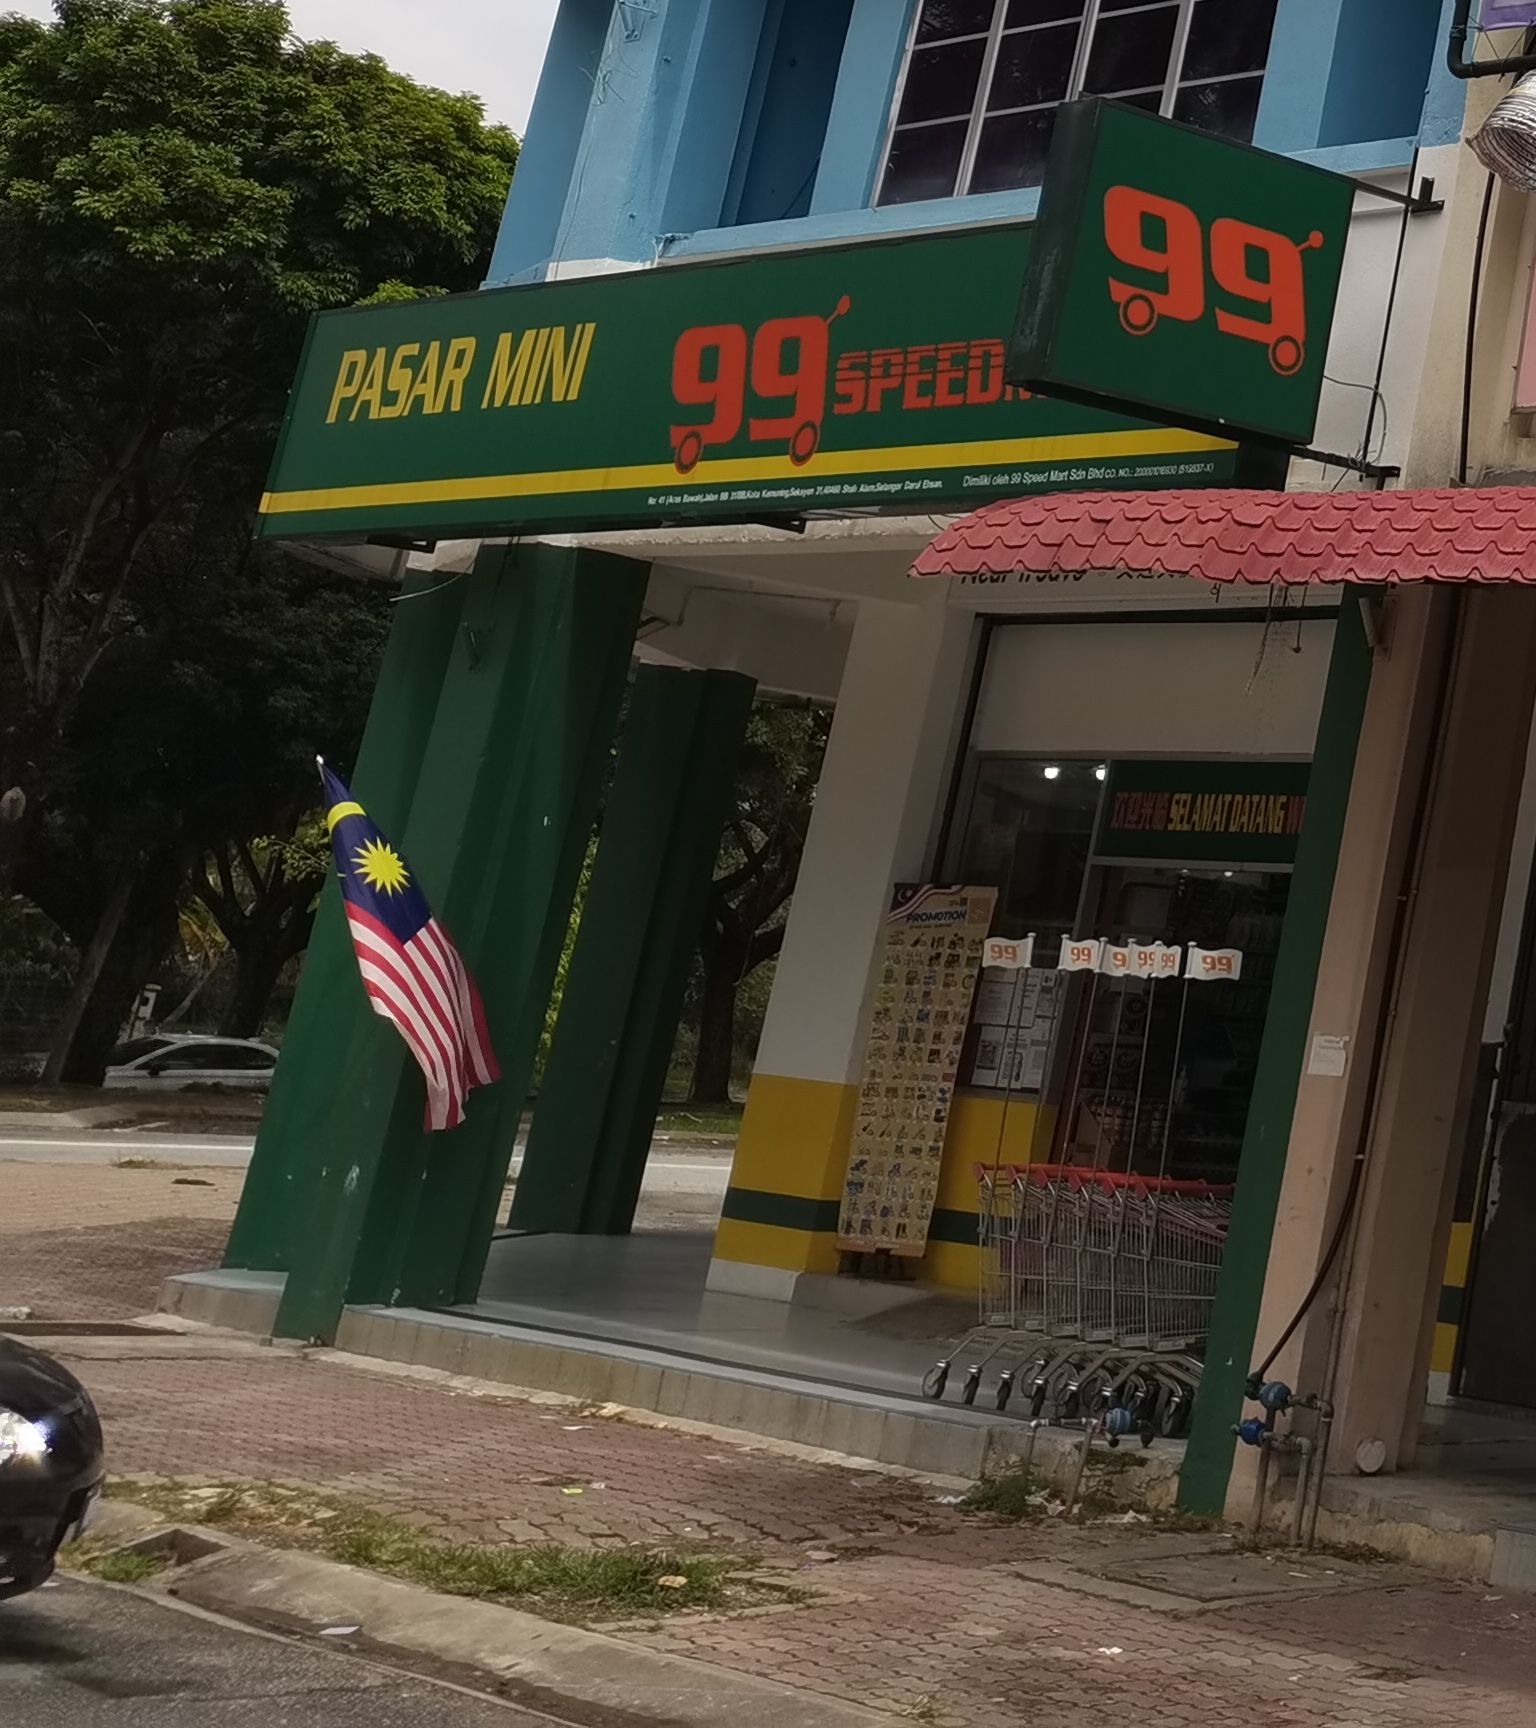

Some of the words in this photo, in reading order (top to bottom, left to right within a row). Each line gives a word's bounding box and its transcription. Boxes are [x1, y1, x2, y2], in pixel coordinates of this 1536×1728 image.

[1102, 183, 1325, 378] 99
[325, 334, 476, 424] PASAR
[480, 322, 597, 411] MINI
[669, 302, 846, 468] 99
[1168, 792, 1233, 832] SELAMAT
[1229, 794, 1288, 834] DATANG
[906, 910, 967, 923] PROMOTION
